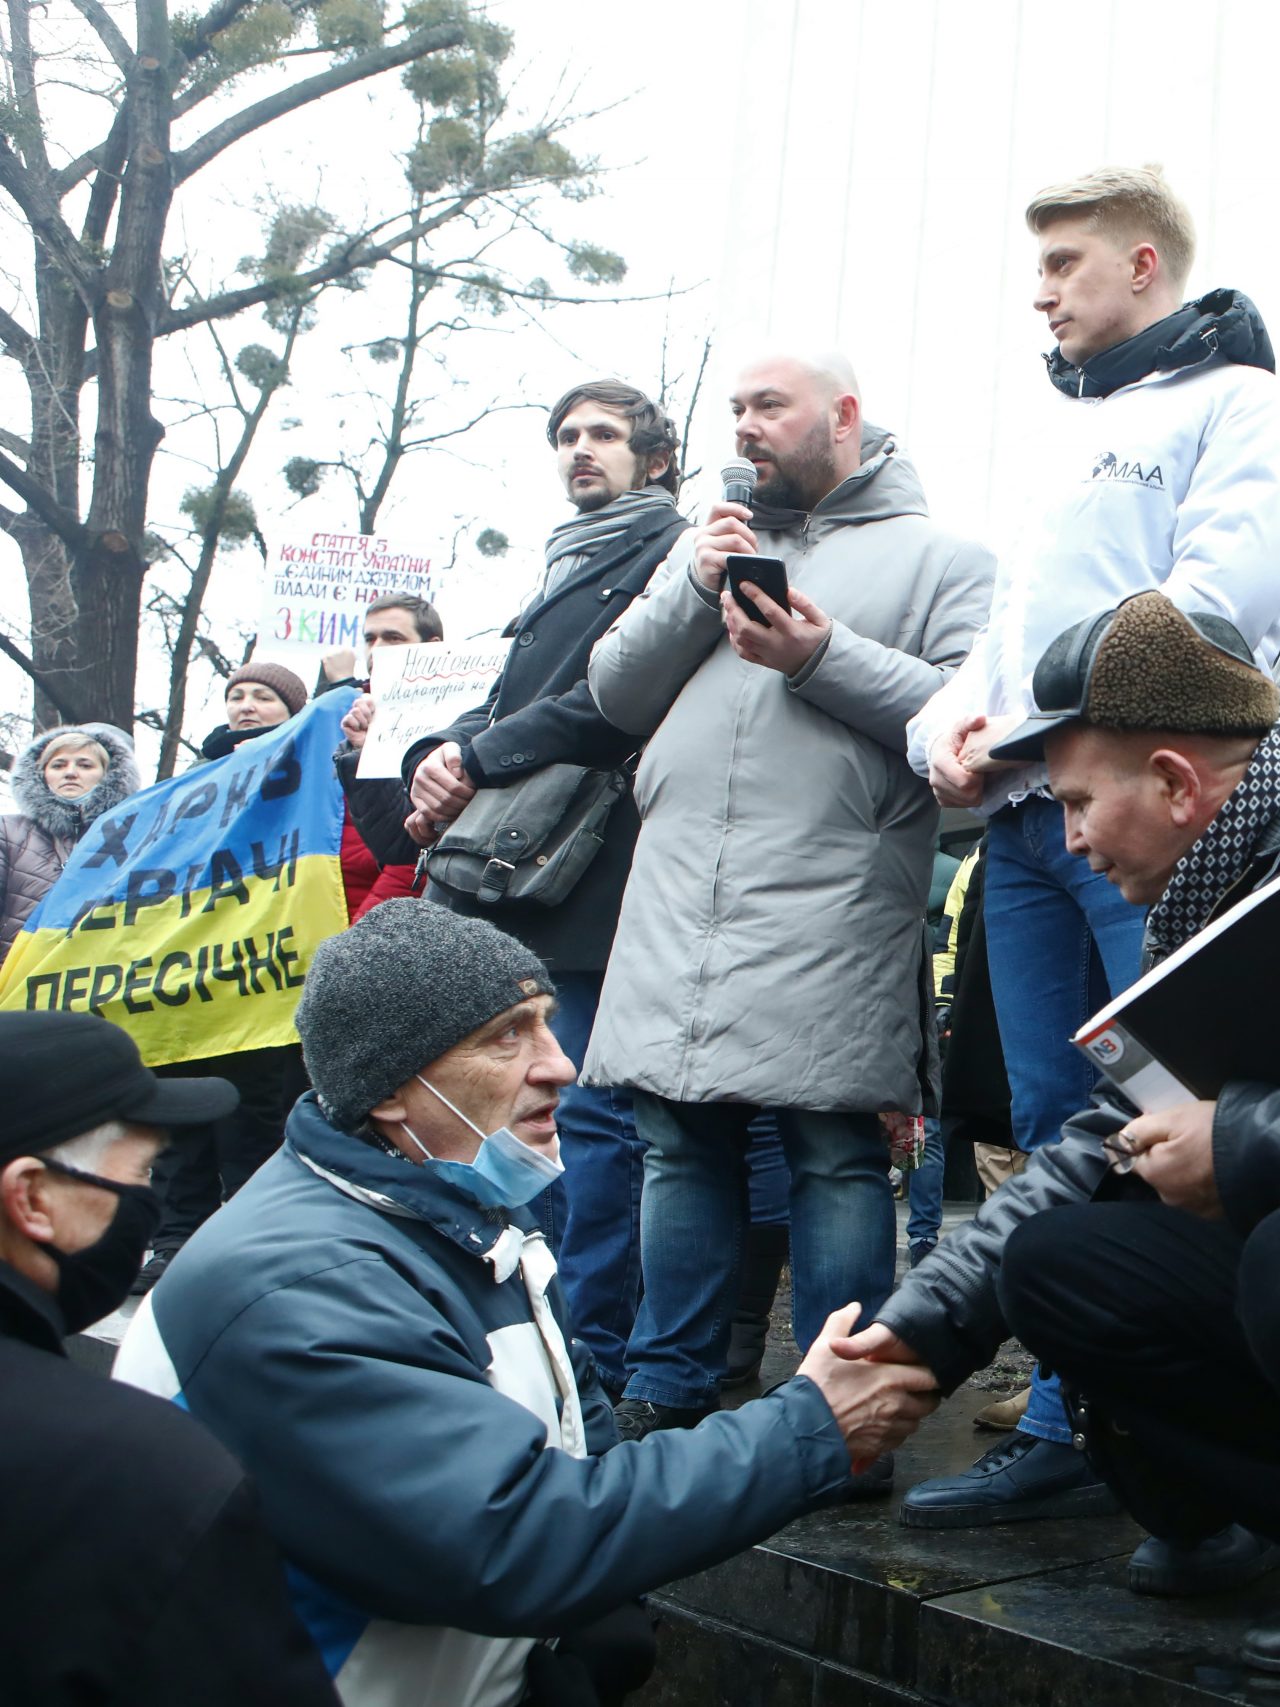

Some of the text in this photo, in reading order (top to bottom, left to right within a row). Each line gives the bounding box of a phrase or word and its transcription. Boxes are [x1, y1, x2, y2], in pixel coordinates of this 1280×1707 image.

[1108, 462, 1163, 485] MAA
[311, 533, 388, 552] СТАТТЯ 5
[363, 552, 431, 574] УКРАЇНИ
[274, 580, 327, 599] ВЛАДИ
[333, 585, 346, 600] Є
[354, 571, 431, 591] ДЖЕРЕЛОМ
[275, 606, 359, 648] З КИМ
[66, 829, 299, 939] ЕРГАЧІ
[27, 926, 305, 1018] ПЕРЕСІЧНЕ
